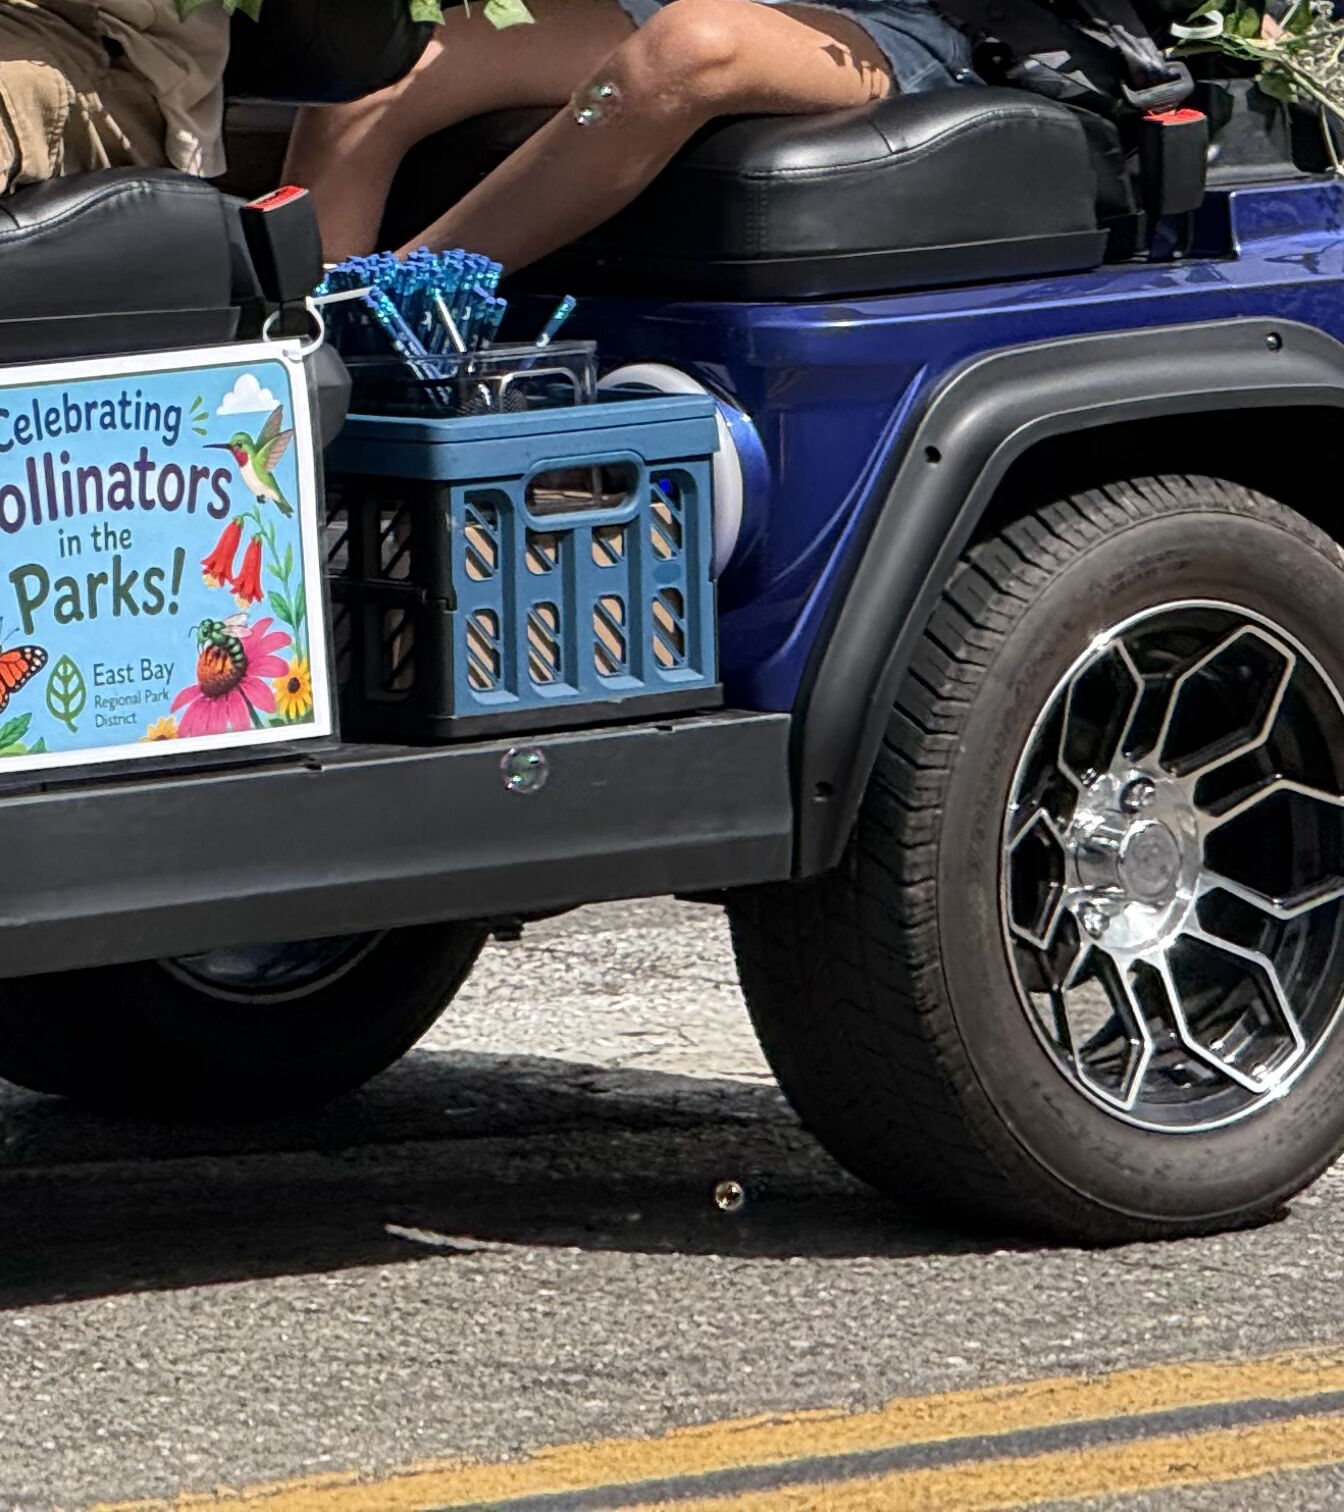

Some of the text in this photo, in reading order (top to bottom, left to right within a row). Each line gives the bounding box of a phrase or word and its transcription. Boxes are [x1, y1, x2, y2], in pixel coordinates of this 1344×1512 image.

[58, 522, 132, 559] in the
[9, 546, 186, 637] Parks!
[93, 658, 175, 687] East Bay
[94, 687, 169, 711] Regional Park
[95, 712, 137, 728] District
